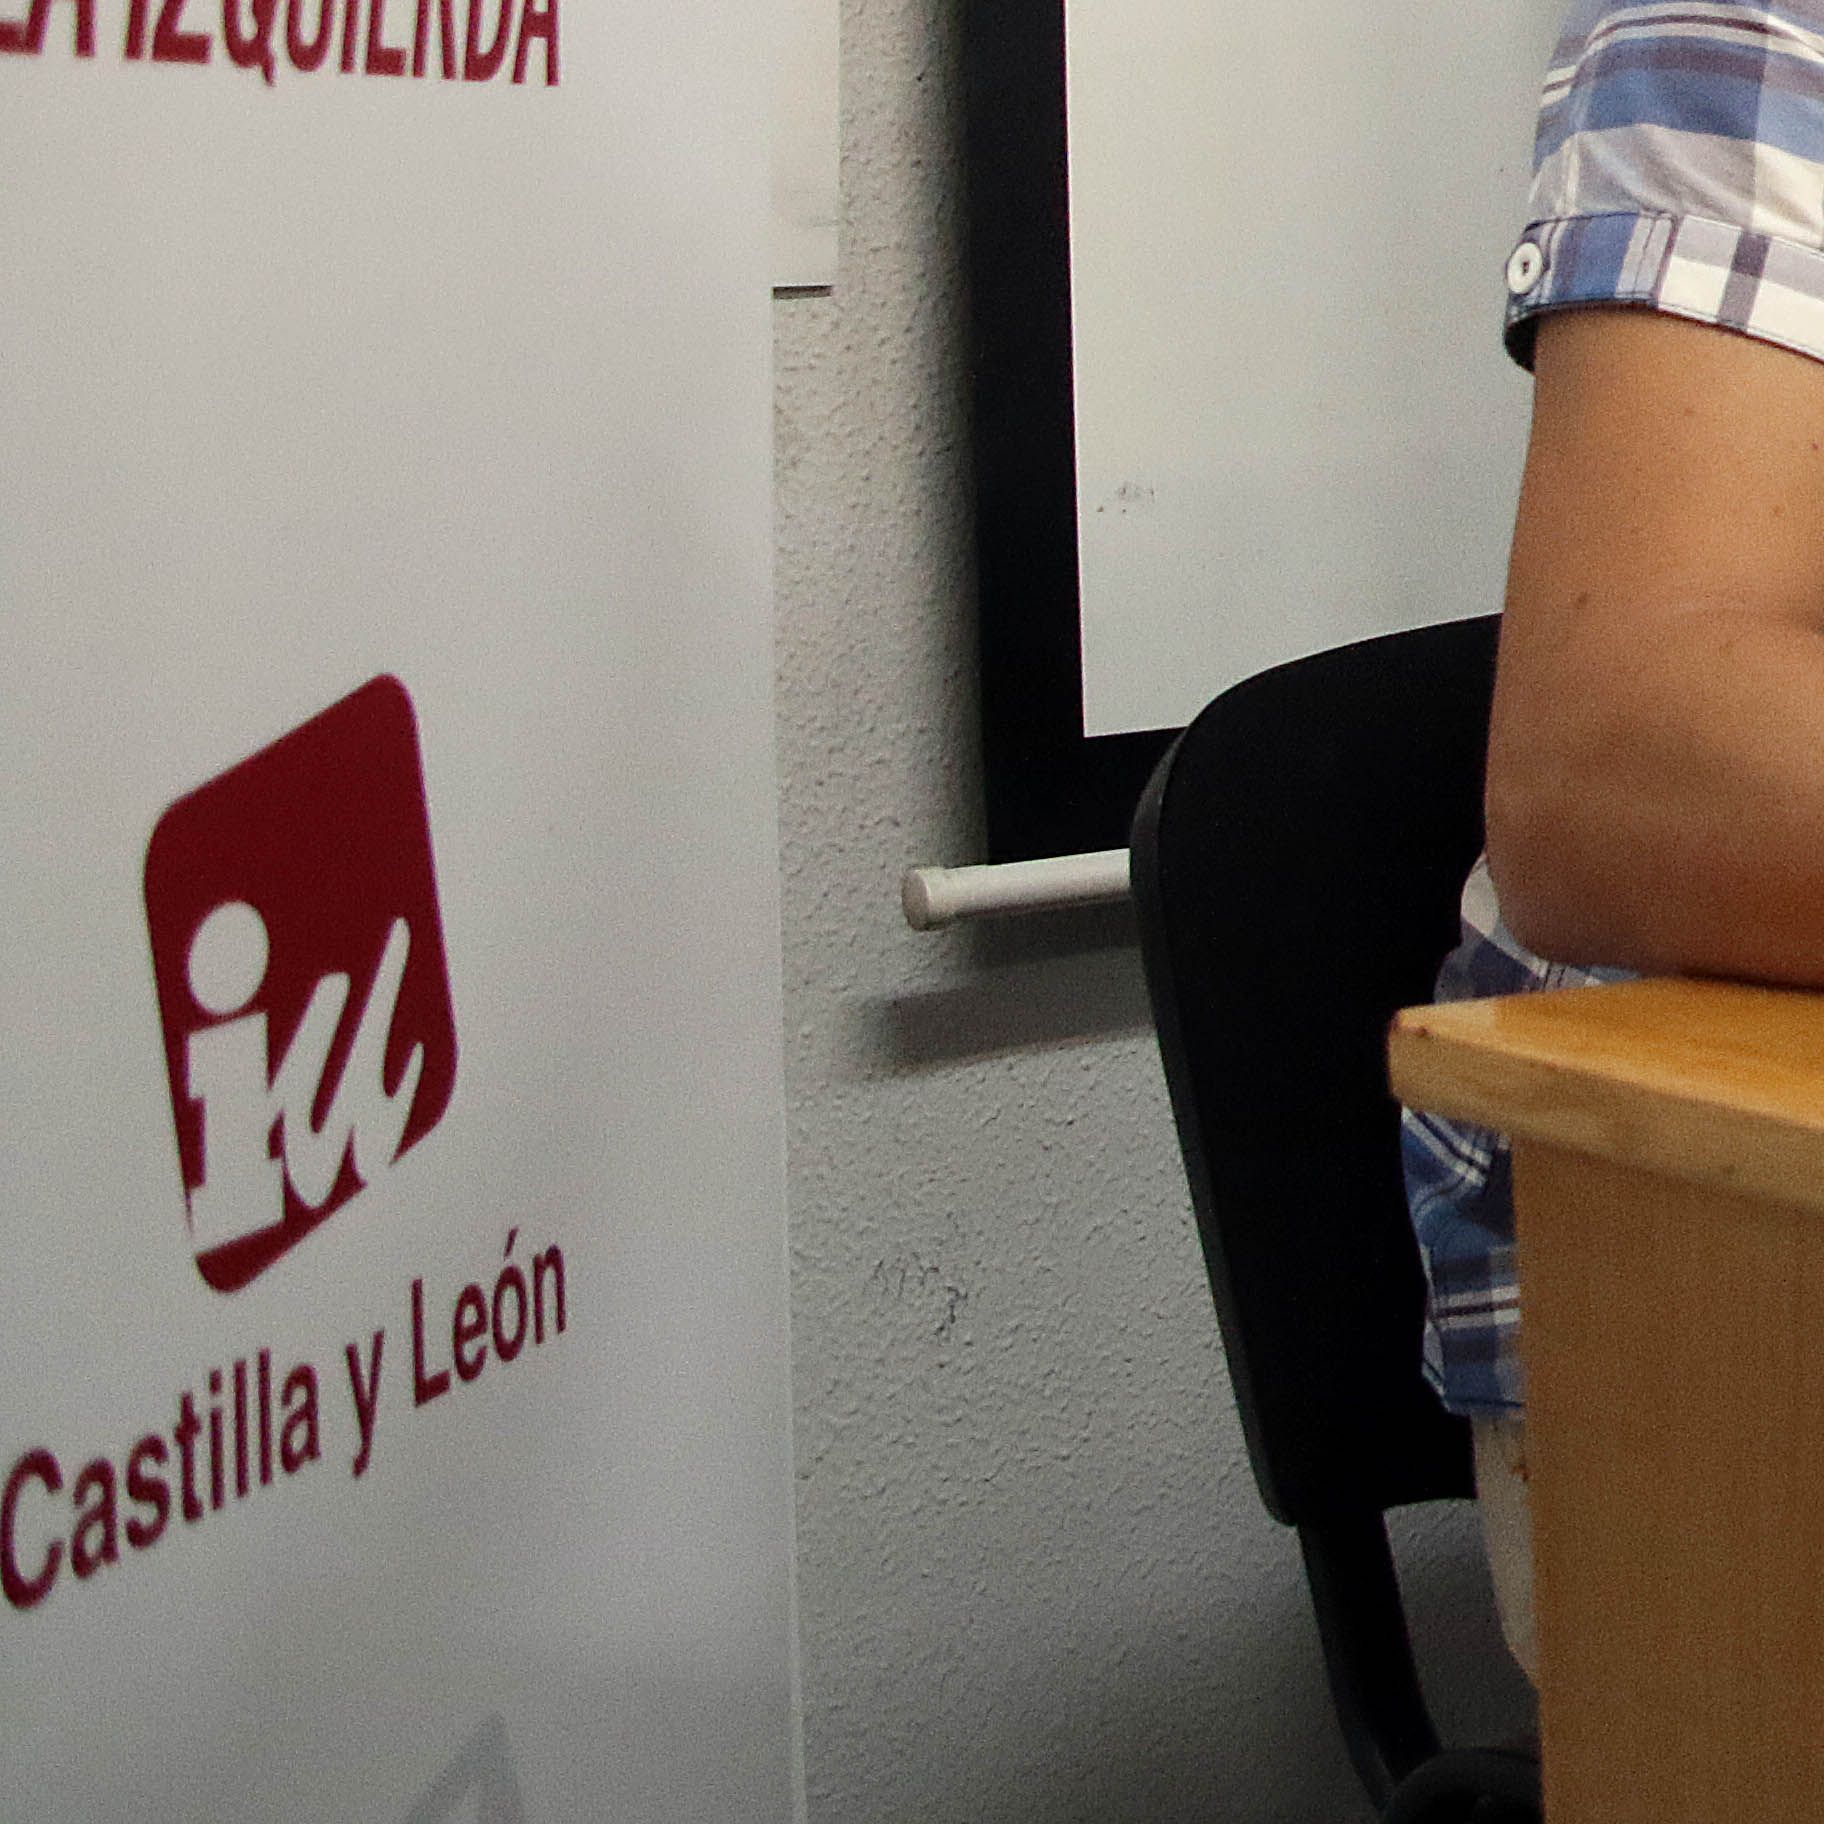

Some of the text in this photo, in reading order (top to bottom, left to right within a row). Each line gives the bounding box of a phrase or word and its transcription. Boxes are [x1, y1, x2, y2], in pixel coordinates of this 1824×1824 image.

[0, 1227, 568, 1611] Castilla y León
